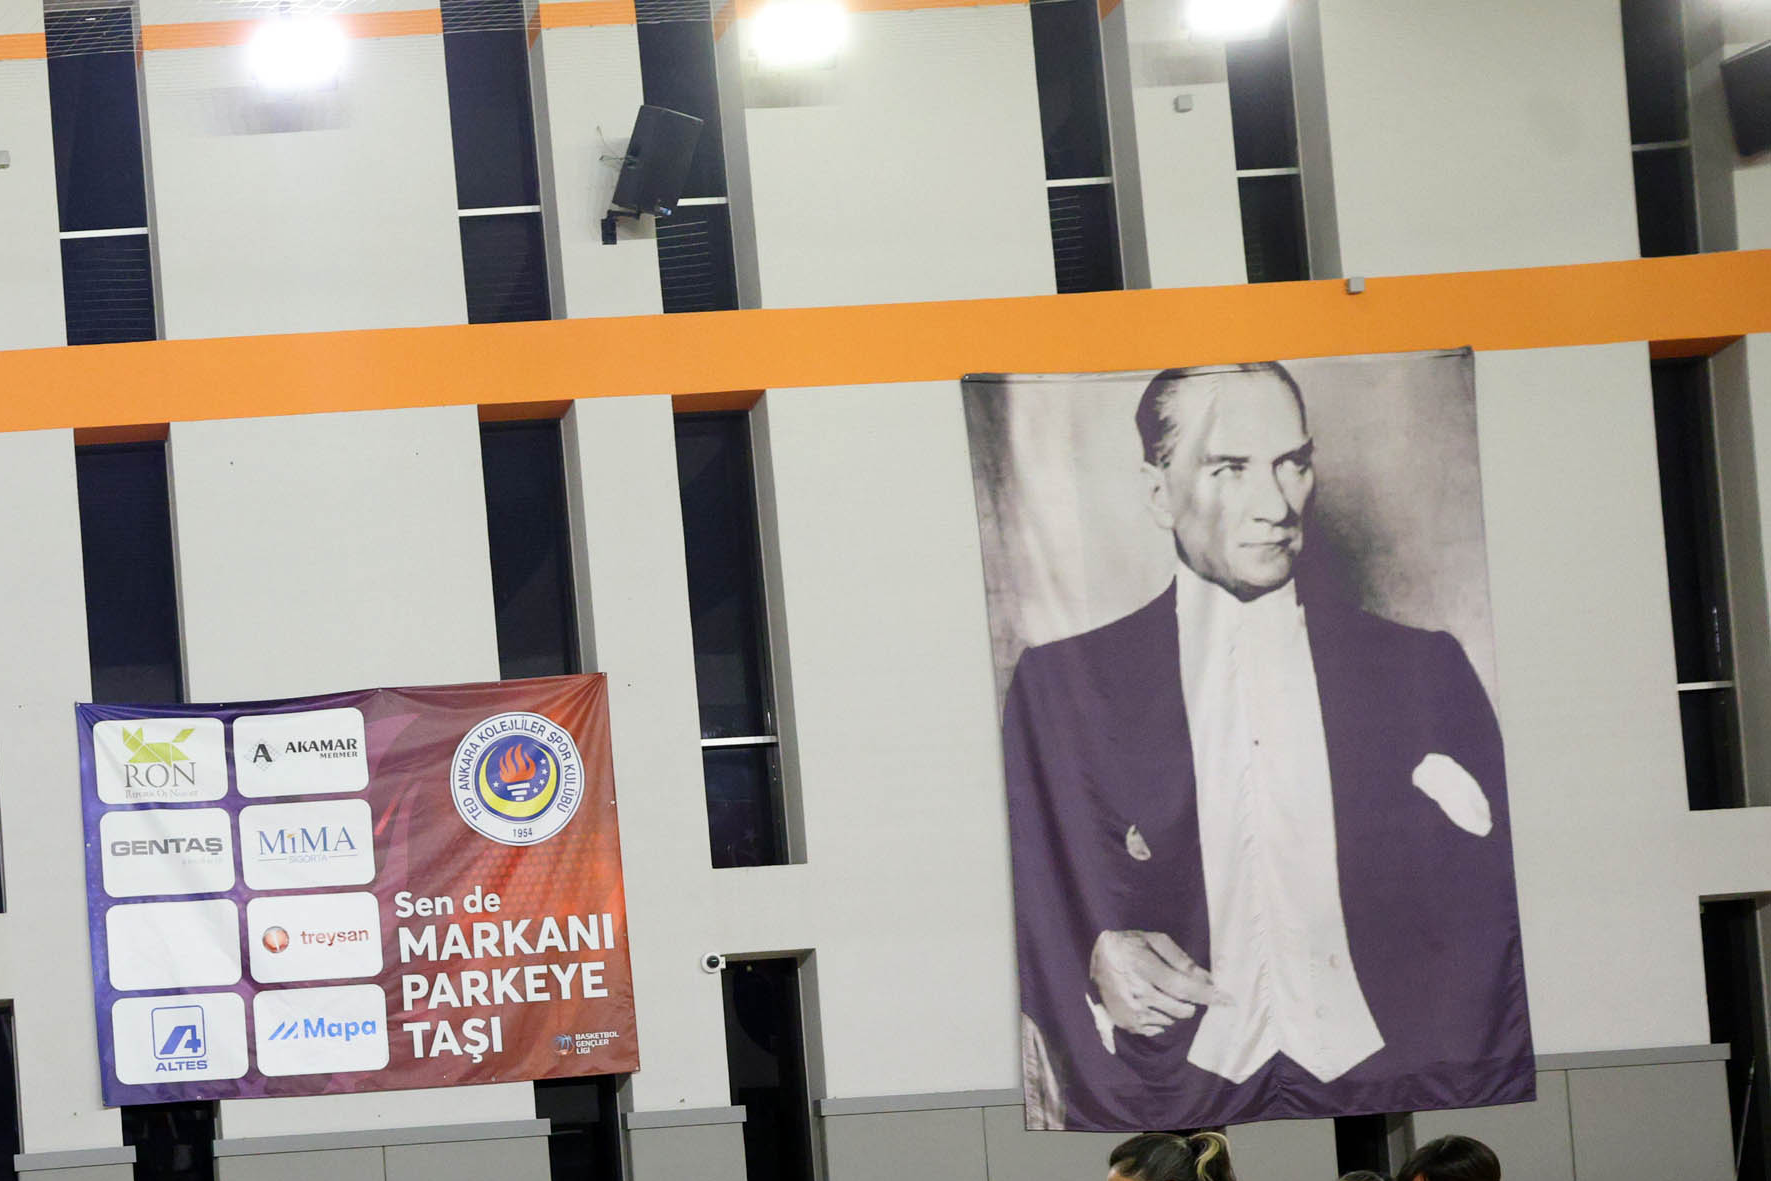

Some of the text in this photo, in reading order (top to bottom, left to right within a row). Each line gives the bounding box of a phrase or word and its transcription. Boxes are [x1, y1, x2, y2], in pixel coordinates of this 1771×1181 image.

[285, 738, 357, 753] AKAMAR
[319, 751, 358, 759] MERMER
[546, 731, 572, 761] SPOR
[123, 762, 196, 788] RON
[458, 741, 480, 791] ANKARA
[556, 763, 578, 813] KULÜBÜ
[462, 797, 482, 820] TED
[512, 828, 533, 838] 1954
[111, 838, 223, 856] GENTAŞ
[394, 885, 501, 918] Sen de
[300, 929, 369, 946] treysan
[398, 913, 615, 963] MARKANI
[402, 961, 609, 1011] PARKEYE
[303, 1018, 377, 1041] Mapa
[402, 1016, 503, 1064] TAŞI
[575, 1031, 620, 1041] BASKETBOL
[155, 1060, 208, 1072] ALTES
